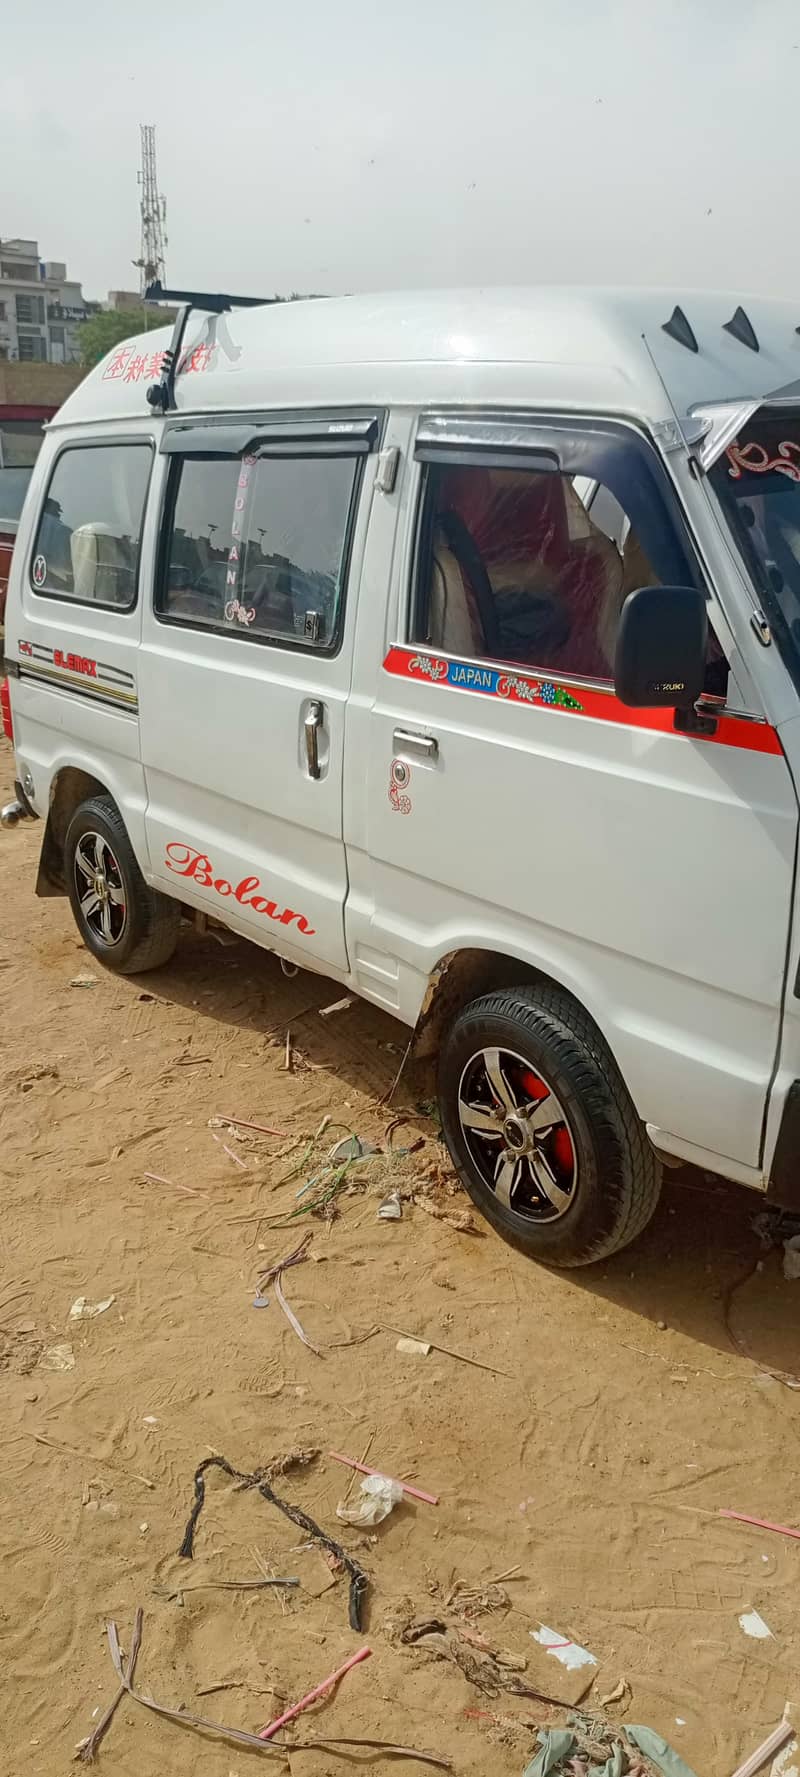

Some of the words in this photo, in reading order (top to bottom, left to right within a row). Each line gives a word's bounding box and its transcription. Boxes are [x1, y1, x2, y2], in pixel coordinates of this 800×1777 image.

[226, 473, 248, 585] BOLAN
[53, 649, 97, 678] ELEMAX
[451, 666, 492, 688] JAPAN
[653, 682, 685, 691] ZUKI
[165, 842, 316, 936] Bolan
